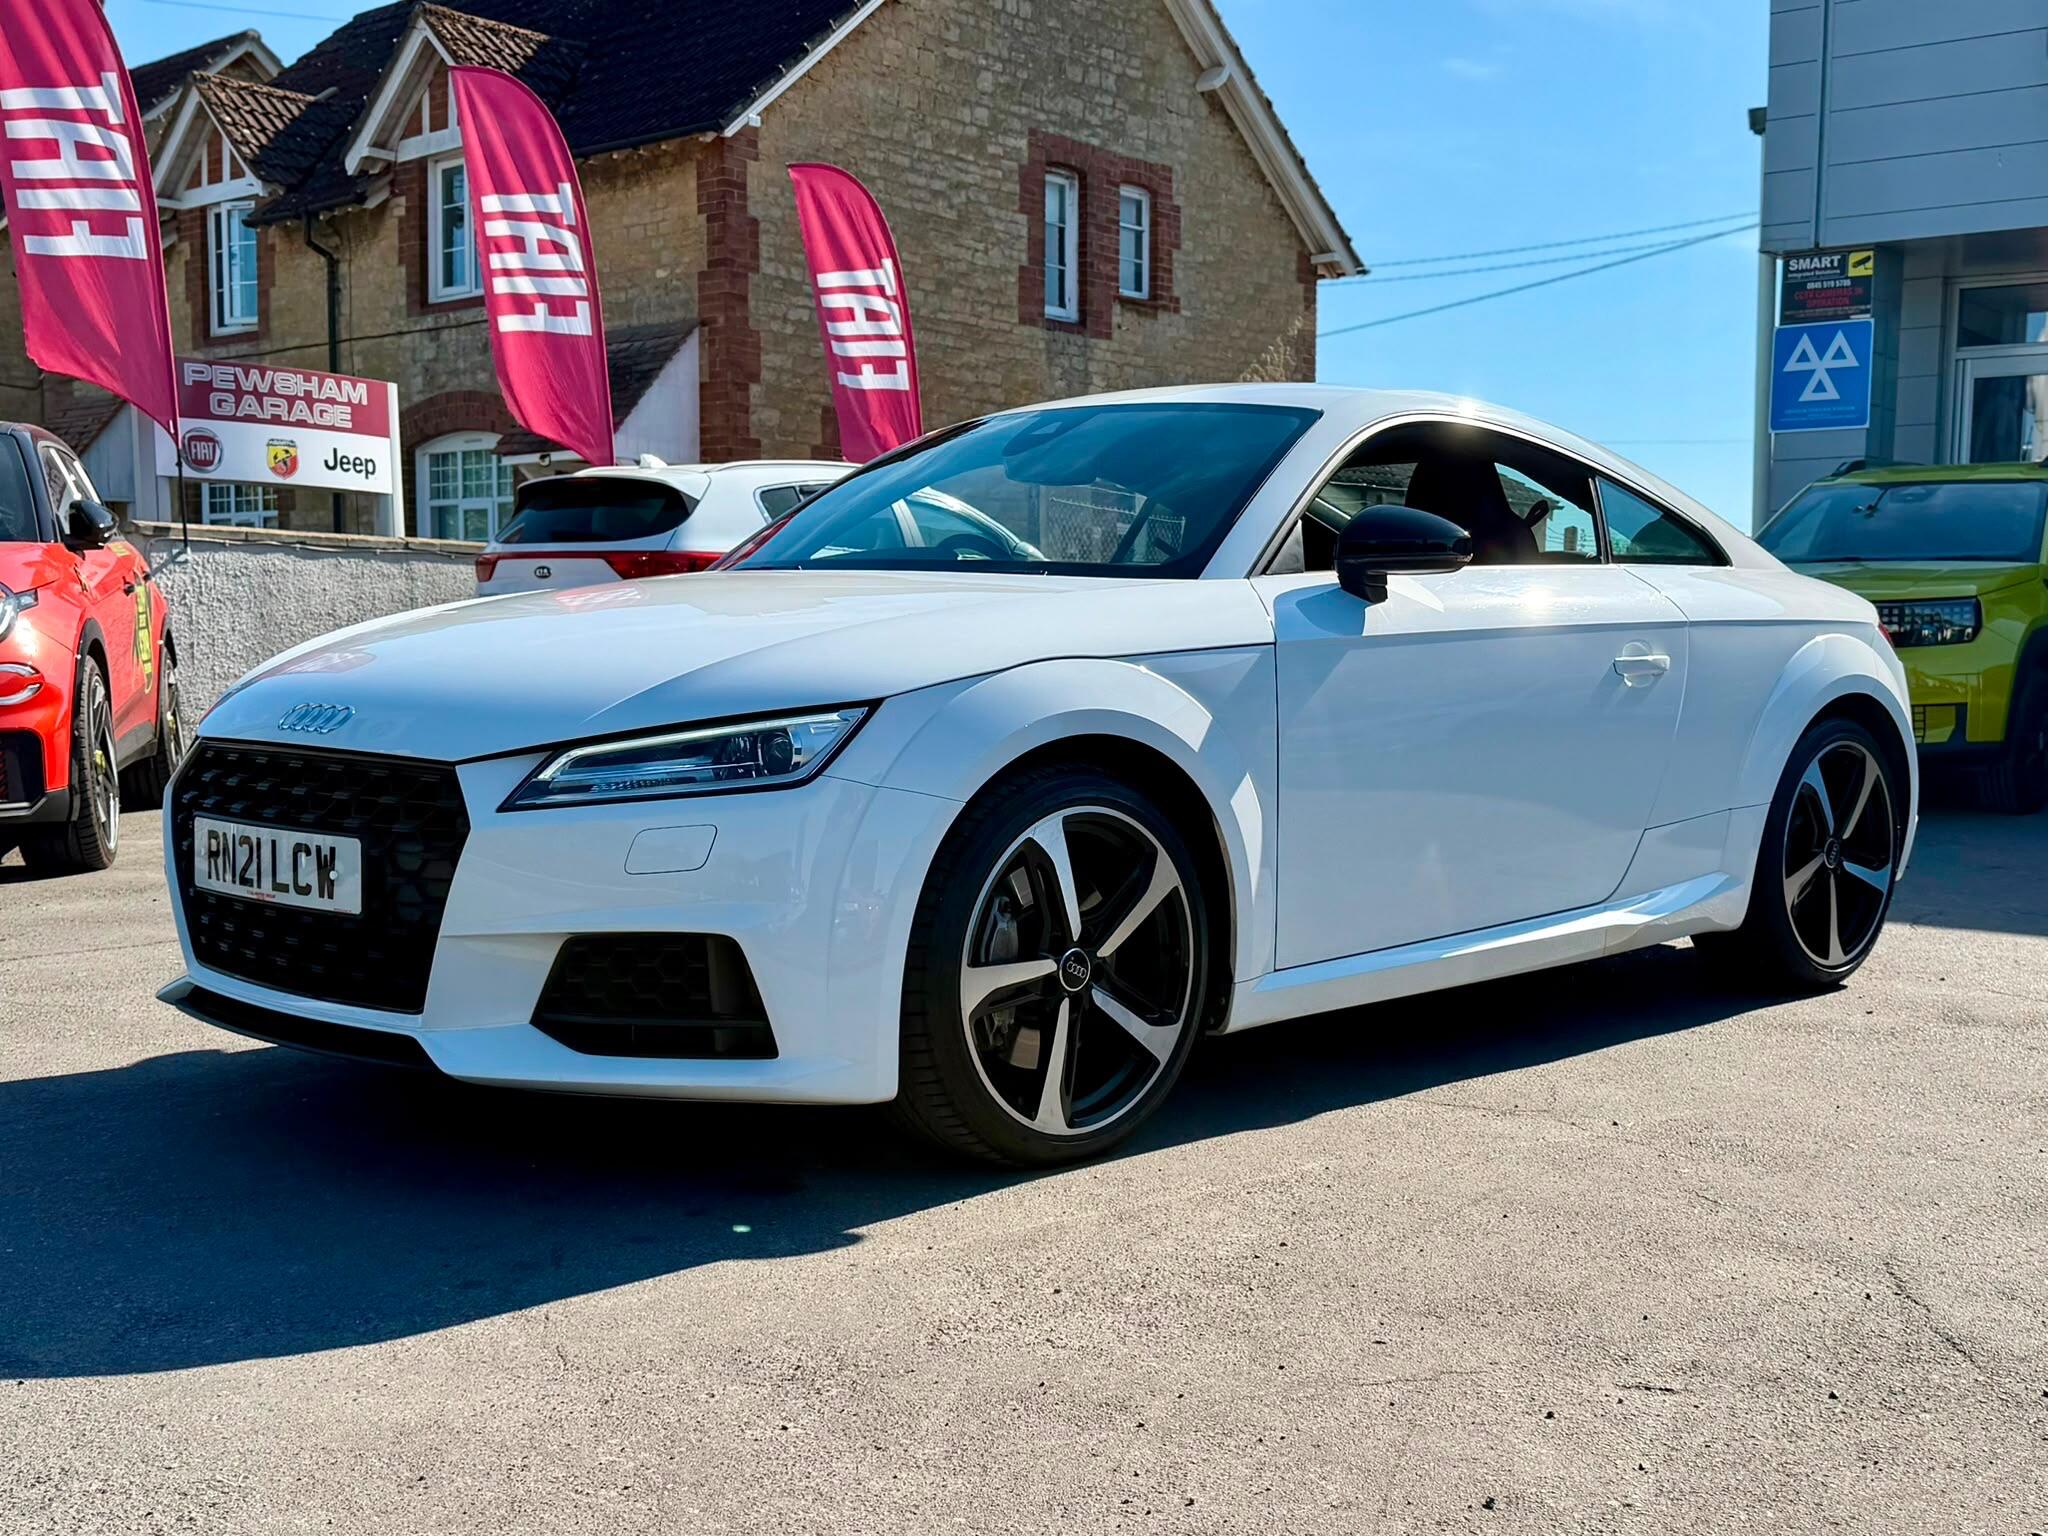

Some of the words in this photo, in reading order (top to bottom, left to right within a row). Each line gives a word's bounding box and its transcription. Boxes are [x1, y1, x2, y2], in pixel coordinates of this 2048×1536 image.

[1788, 256, 1841, 271] SMART
[184, 362, 368, 406] PEWSHAM
[209, 392, 353, 428] GARAGE
[191, 441, 217, 460] FIAT
[323, 447, 377, 480] Jeep
[206, 829, 262, 889] RN21
[271, 839, 336, 900] LCW
